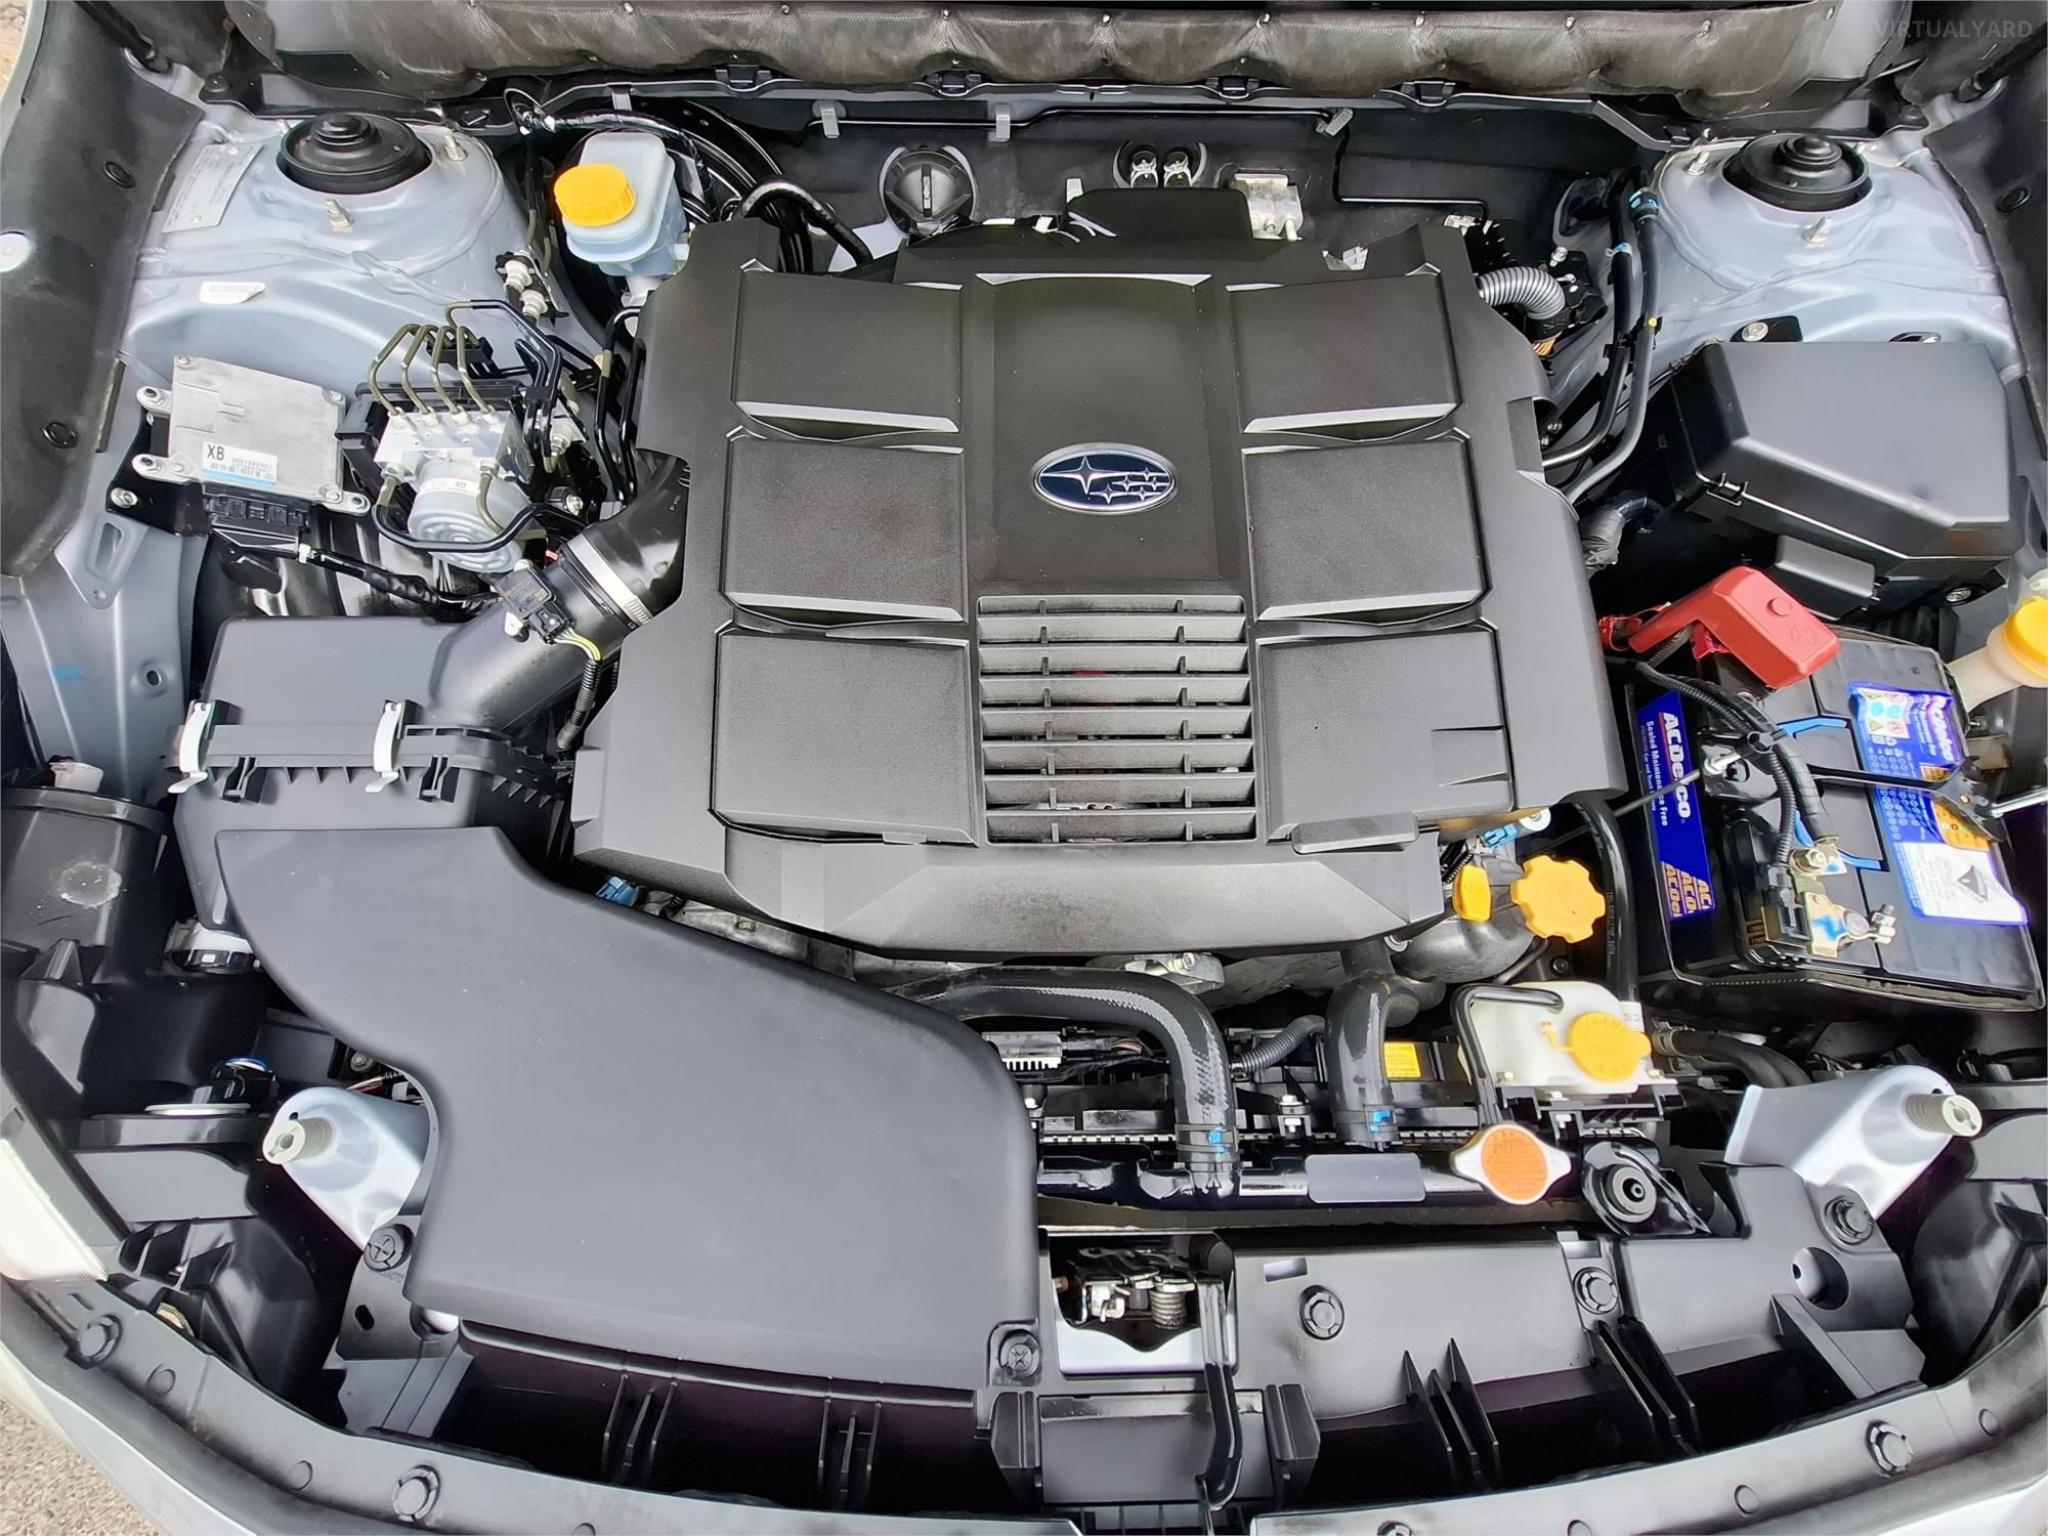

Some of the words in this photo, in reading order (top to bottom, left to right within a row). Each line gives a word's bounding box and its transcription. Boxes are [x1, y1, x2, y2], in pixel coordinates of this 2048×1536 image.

[207, 443, 225, 461] XB
[1651, 750, 1665, 805] Maintenace
[1660, 806, 1668, 826] Free
